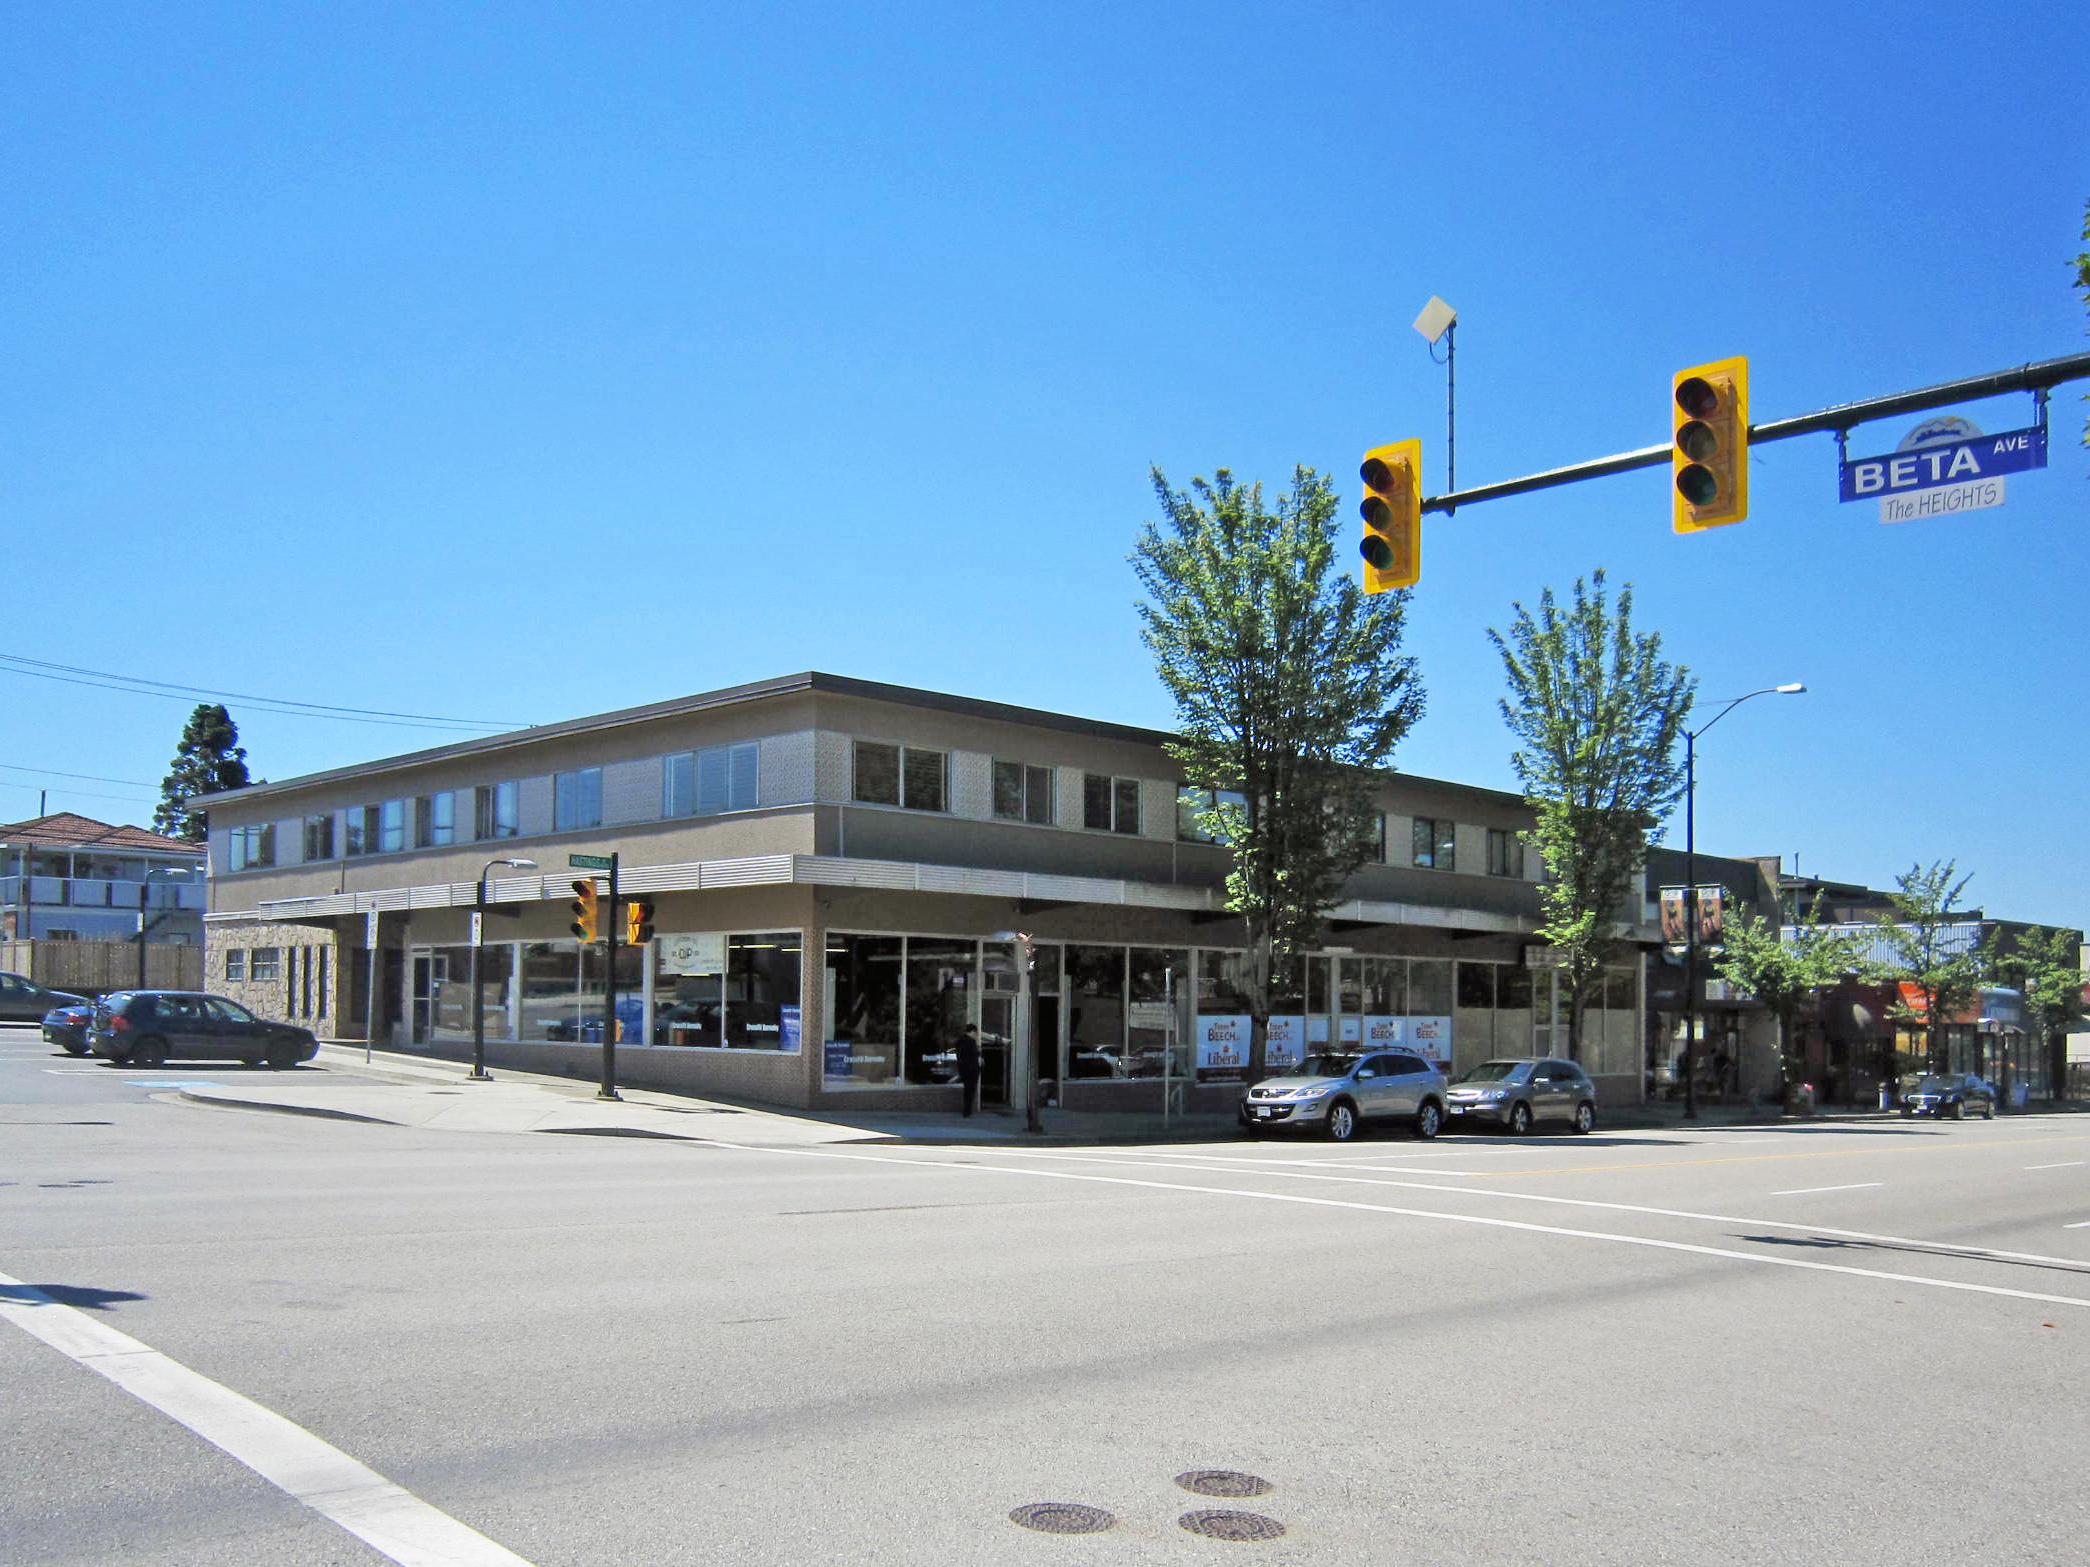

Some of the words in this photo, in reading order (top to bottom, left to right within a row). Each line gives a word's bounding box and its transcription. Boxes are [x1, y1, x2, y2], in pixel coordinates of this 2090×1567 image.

[1855, 445, 1981, 494] BETA
[1993, 435, 2029, 455] AVE
[1887, 499, 1914, 520] The
[1919, 483, 1997, 515] HEIGHTS
[1208, 1027, 1236, 1041] BEECH
[1266, 1030, 1289, 1041] EECH
[1208, 1050, 1240, 1065] Liberal
